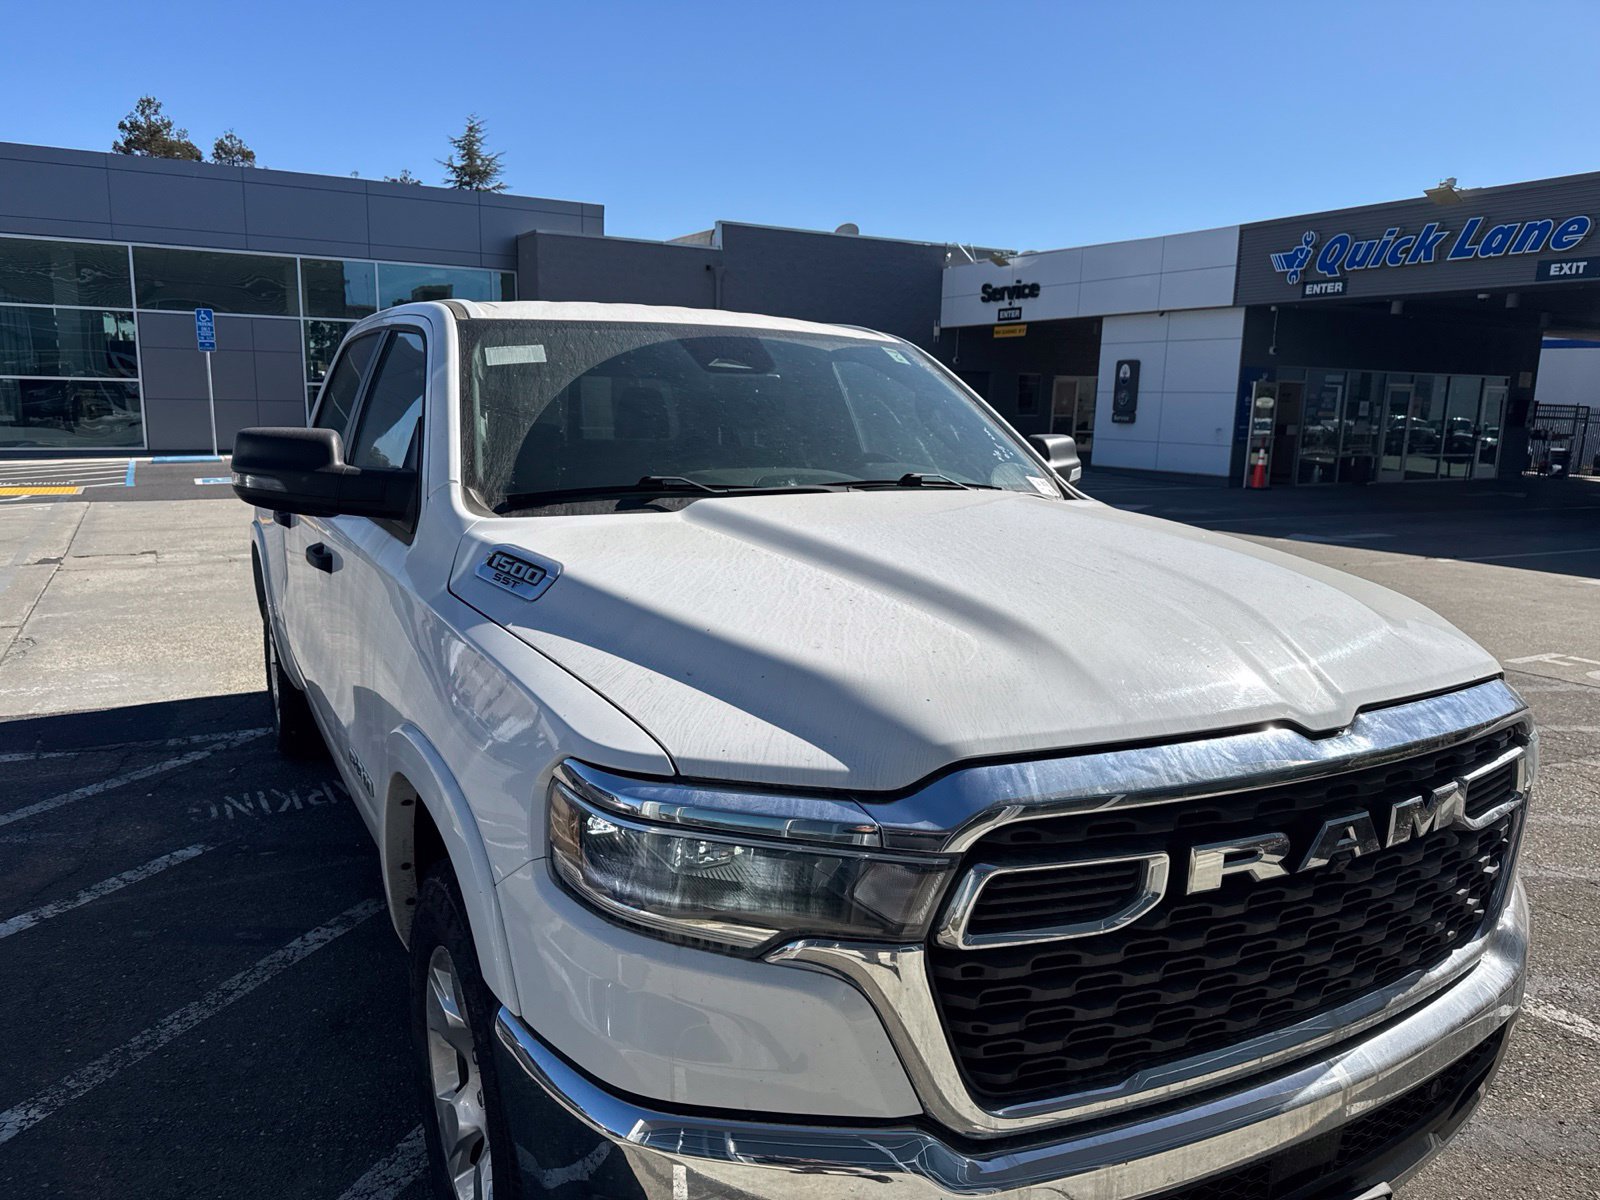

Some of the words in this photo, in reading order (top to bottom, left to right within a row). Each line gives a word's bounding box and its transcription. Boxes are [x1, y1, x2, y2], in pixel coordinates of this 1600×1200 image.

[1316, 222, 1450, 277] Quick
[1447, 215, 1592, 261] Lane
[1550, 261, 1588, 277] EXIT
[981, 280, 1040, 303] Service
[1305, 281, 1343, 295] ENTER
[999, 309, 1020, 319] ENTER
[491, 554, 545, 583] 1500
[493, 573, 520, 588] SST
[1186, 781, 1464, 896] RAM
